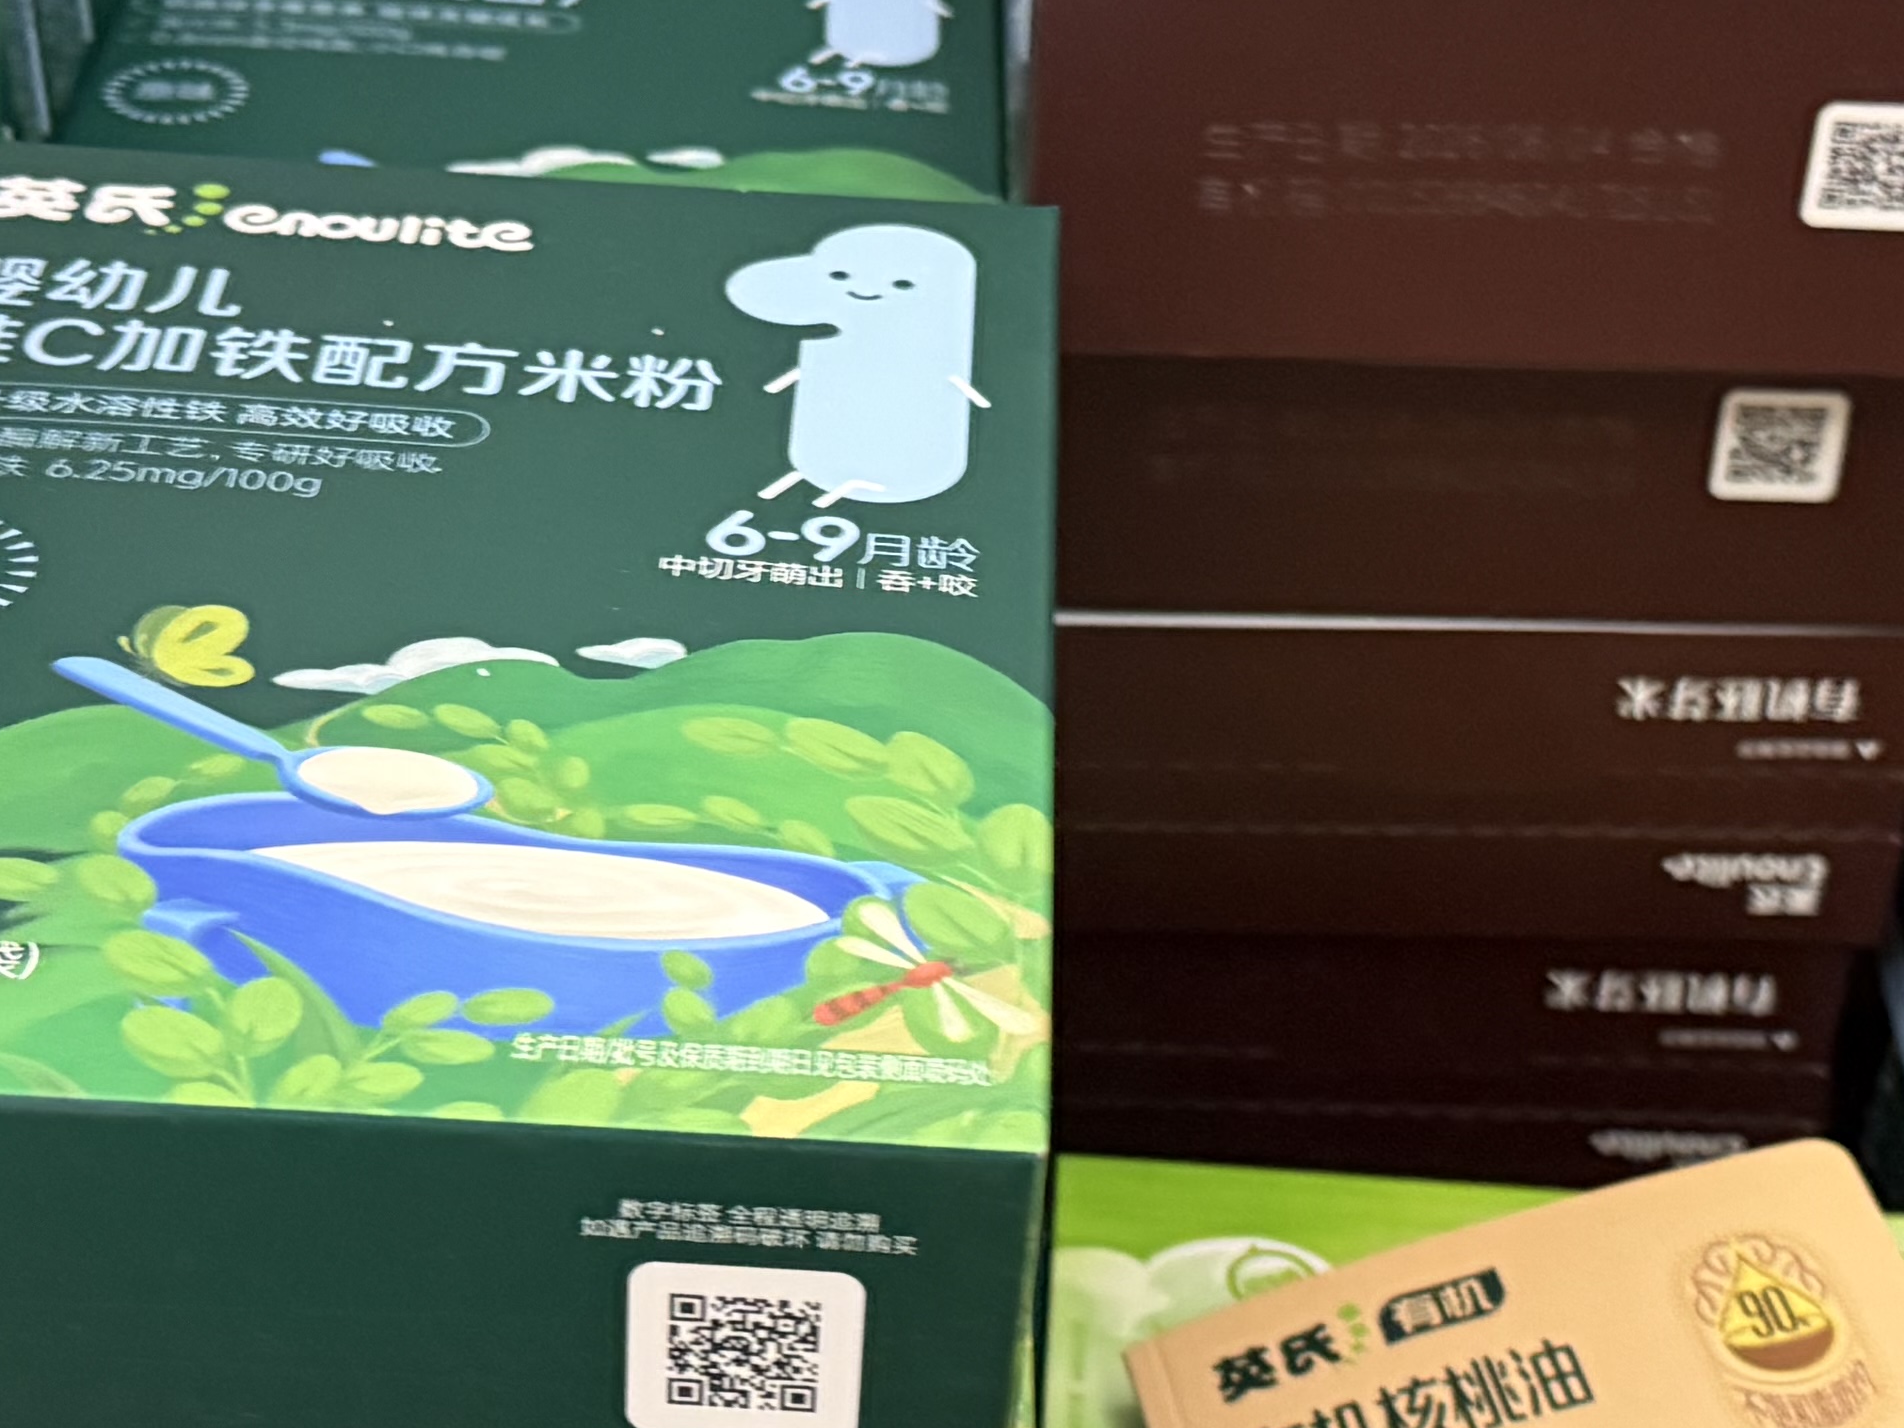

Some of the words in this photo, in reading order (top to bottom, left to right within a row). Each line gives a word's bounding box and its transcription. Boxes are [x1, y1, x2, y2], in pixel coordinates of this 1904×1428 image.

[221, 207, 536, 254] enoulite
[237, 403, 455, 440] 高效好吸收
[44, 458, 323, 499] 6.25mg/100g
[705, 509, 981, 573] 6-9月龄
[1211, 1321, 1343, 1404] 英氏
